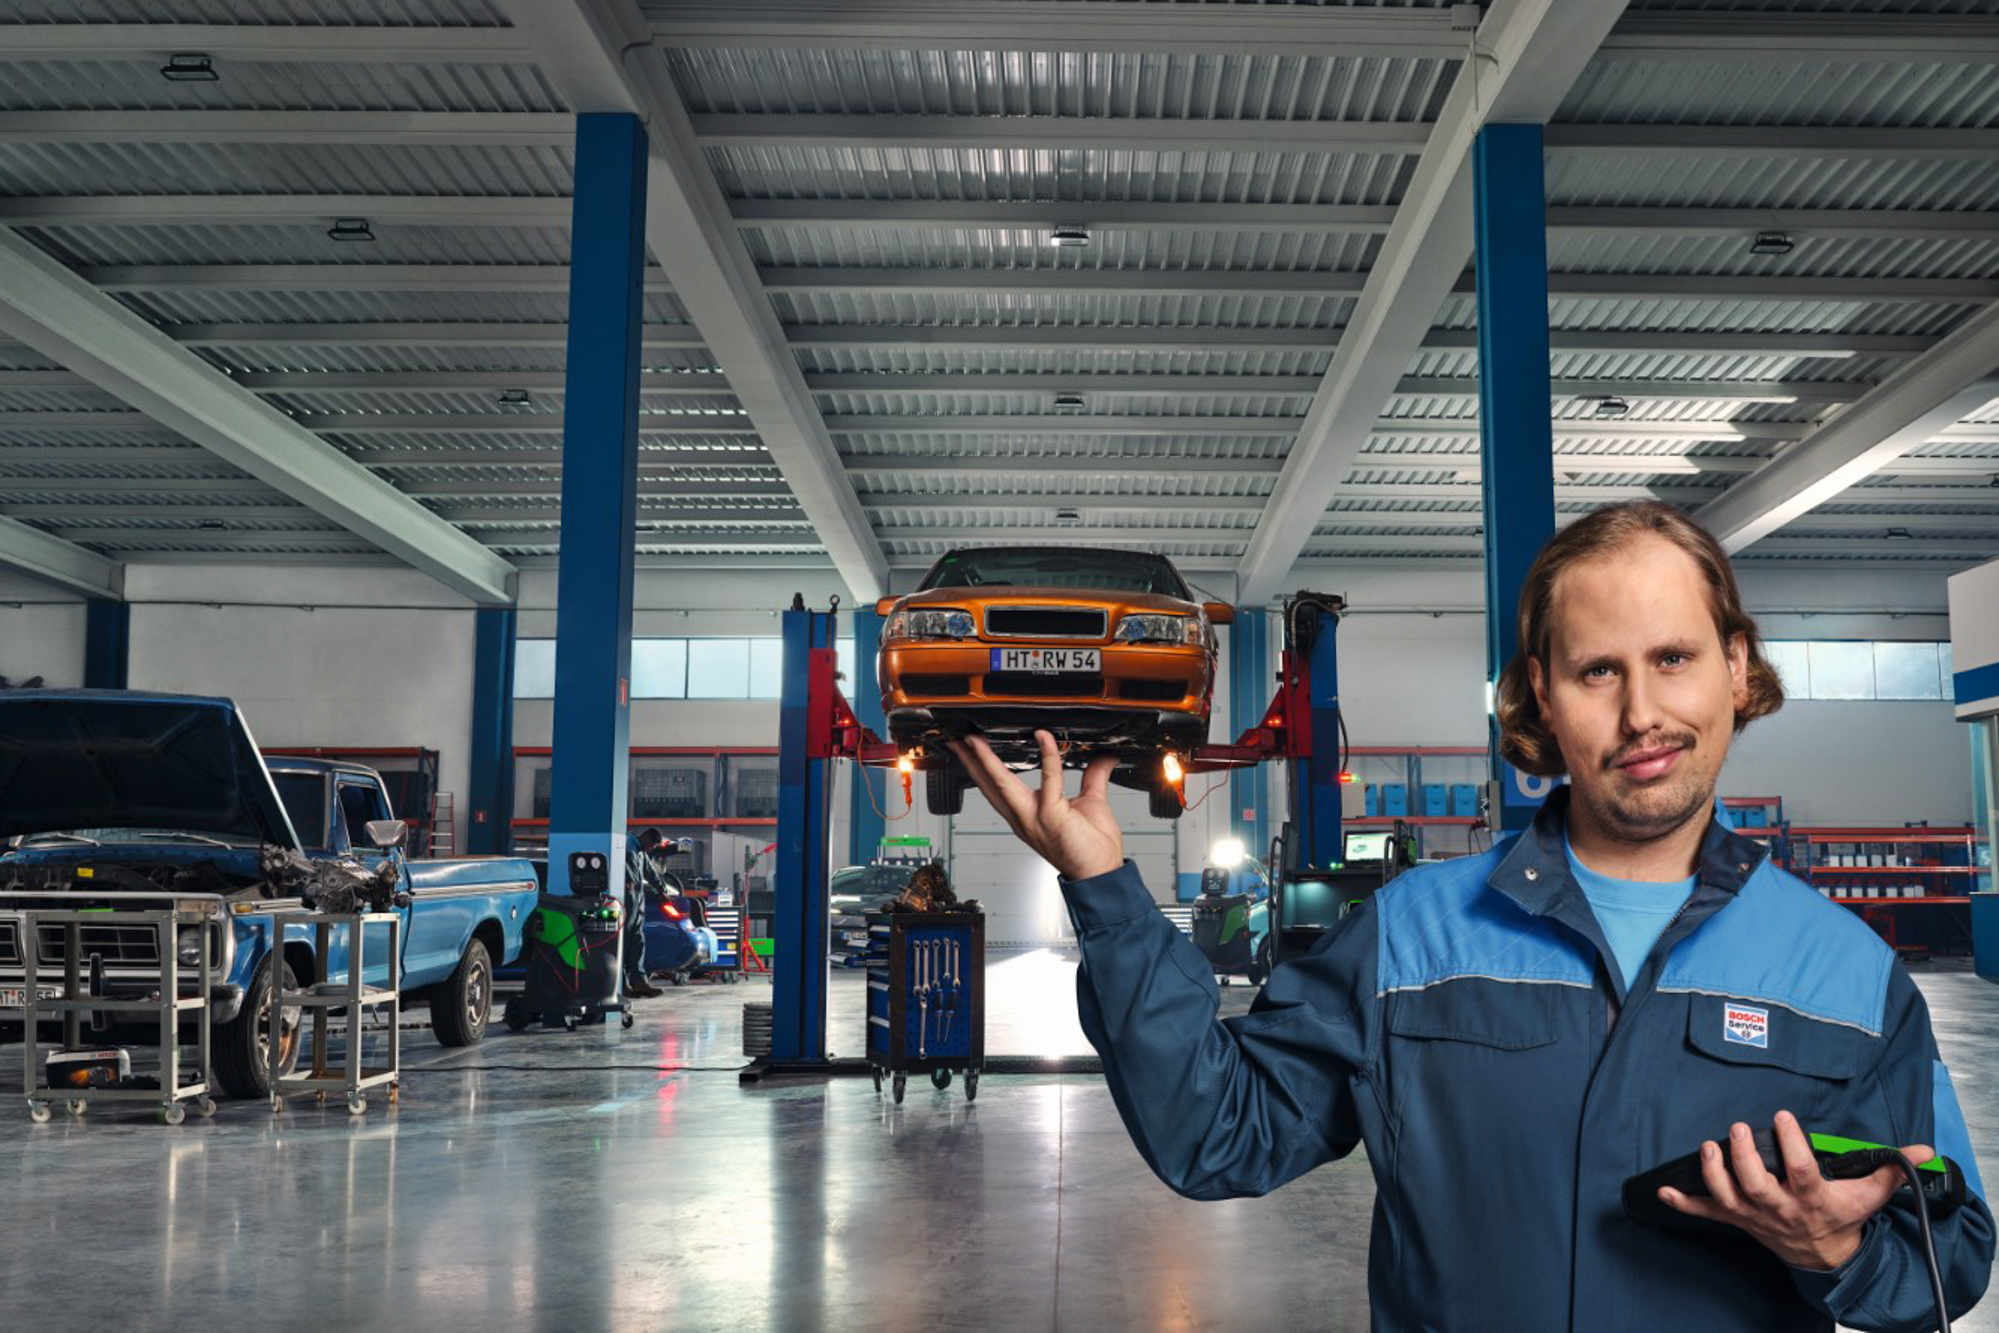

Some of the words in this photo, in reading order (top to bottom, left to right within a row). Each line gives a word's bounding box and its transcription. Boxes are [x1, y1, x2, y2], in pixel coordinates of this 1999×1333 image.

[1007, 651, 1031, 668] HT
[1043, 651, 1067, 668] RW
[1073, 651, 1096, 669] 54
[1728, 1010, 1765, 1024] BOSCH
[1728, 1020, 1765, 1032] Service
